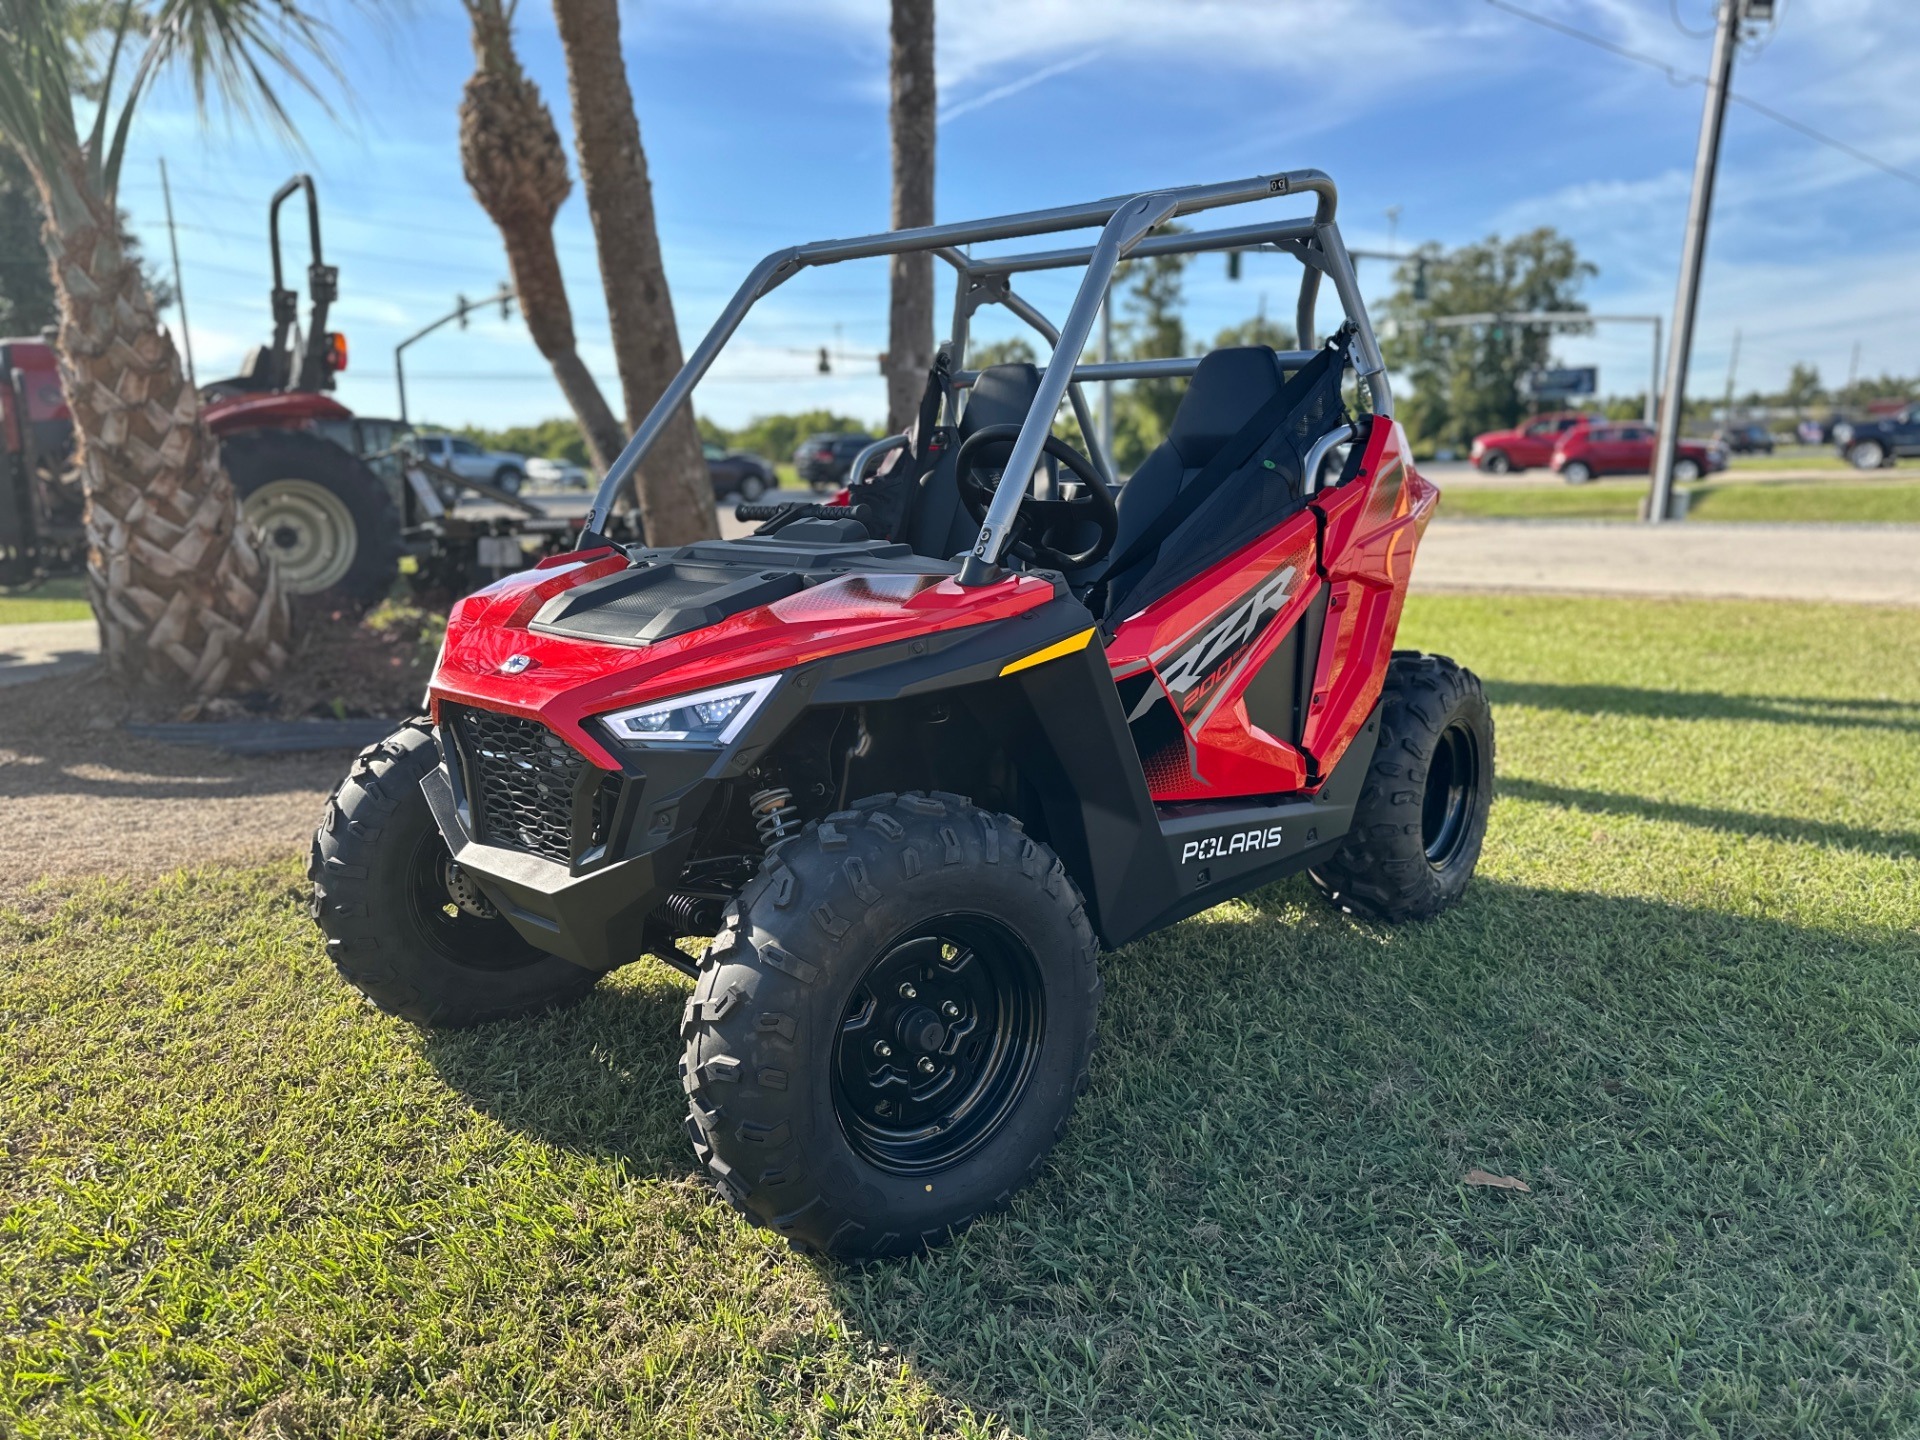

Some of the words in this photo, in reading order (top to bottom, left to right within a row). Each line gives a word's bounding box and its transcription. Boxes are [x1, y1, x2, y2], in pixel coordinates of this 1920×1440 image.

[1127, 565, 1297, 724] RZR
[1183, 656, 1233, 713] 200
[1181, 826, 1283, 865] POLARIS
